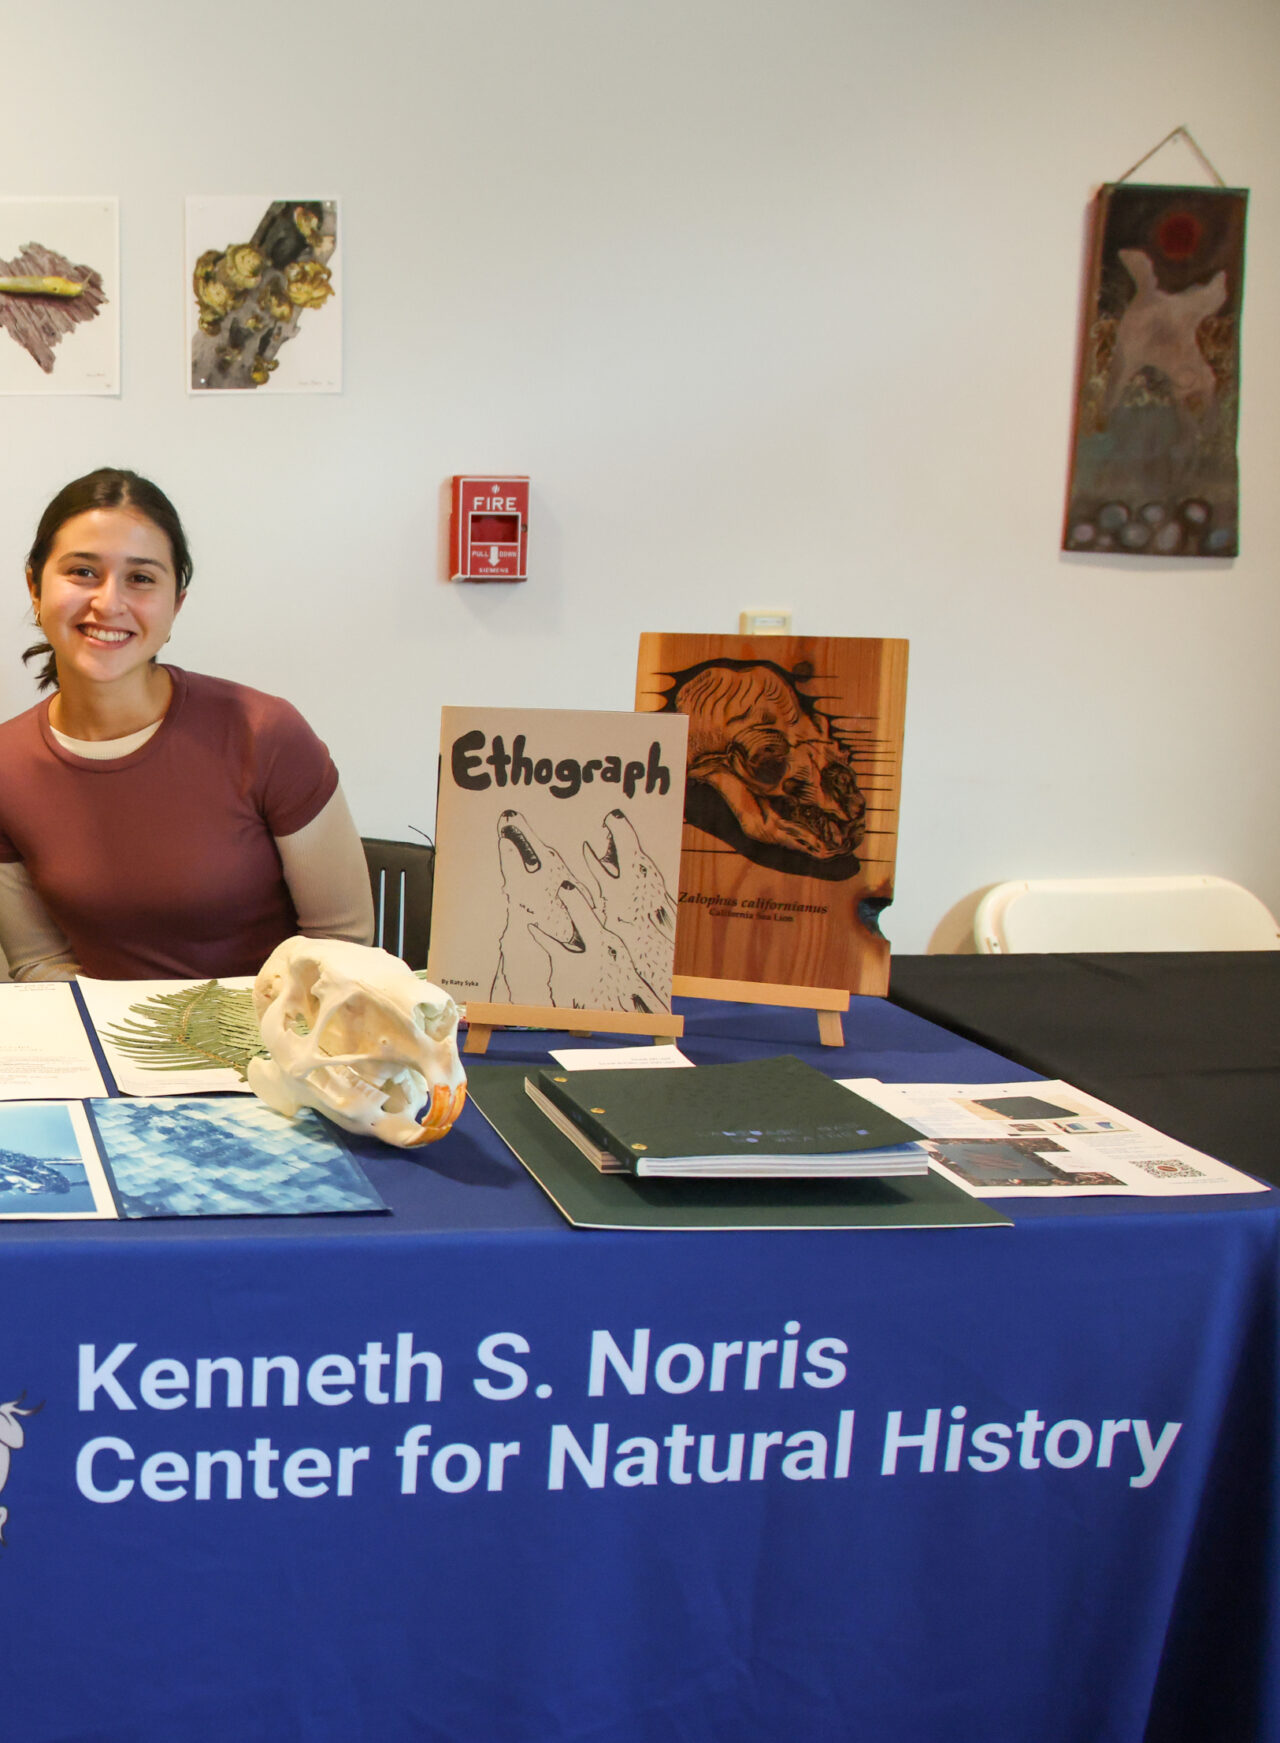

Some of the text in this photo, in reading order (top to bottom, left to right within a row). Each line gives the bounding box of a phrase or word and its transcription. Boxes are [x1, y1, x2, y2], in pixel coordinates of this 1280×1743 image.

[473, 497, 517, 511] FIRE
[451, 730, 670, 799] Ethograph
[678, 892, 828, 914] Zalophus californianus
[709, 907, 754, 919] California
[774, 914, 794, 922] Lion
[78, 1320, 848, 1411] Kenneth S. Norris
[76, 1405, 1182, 1503] Center for Natural History
